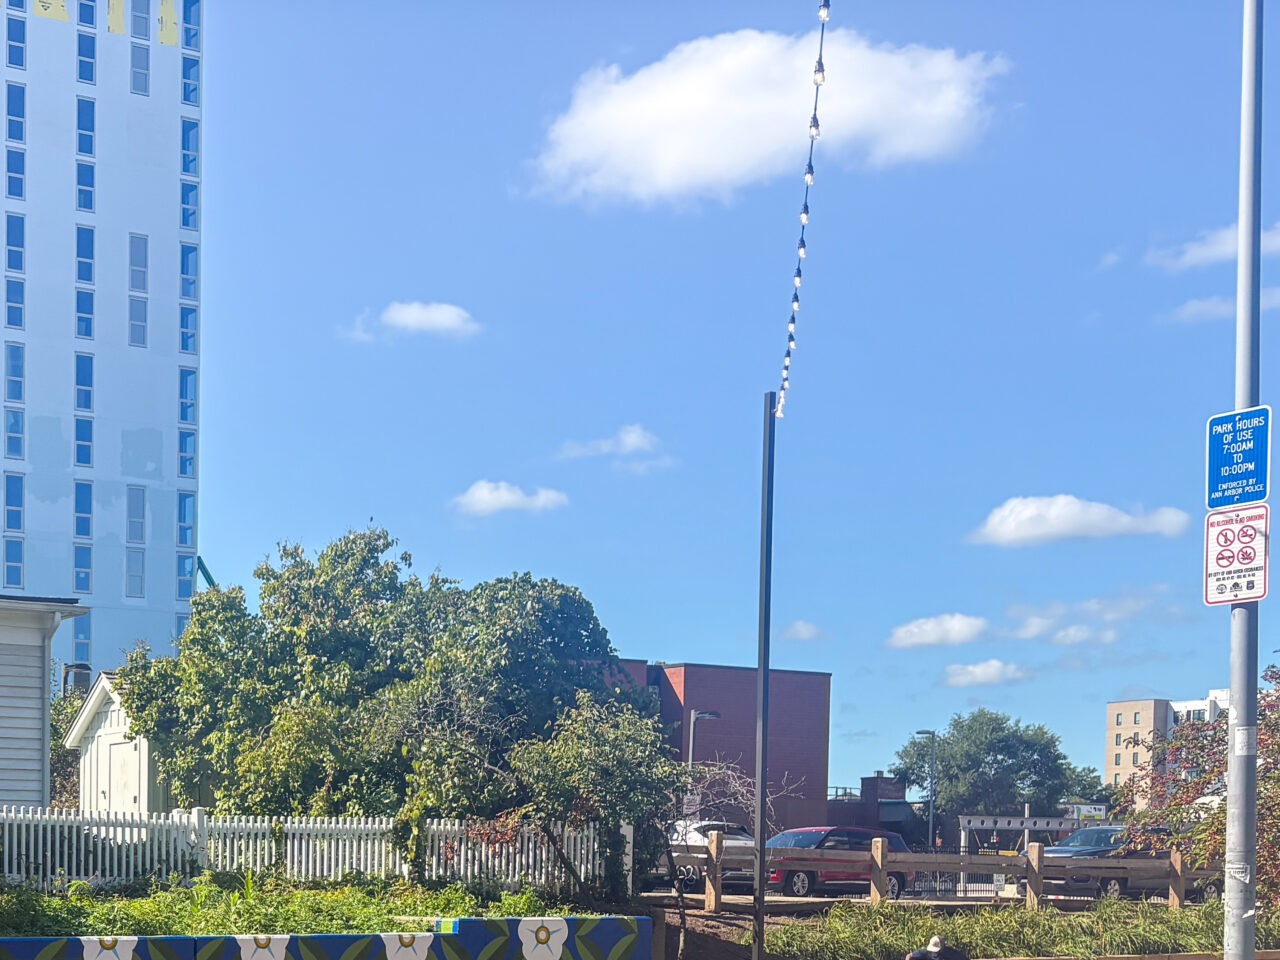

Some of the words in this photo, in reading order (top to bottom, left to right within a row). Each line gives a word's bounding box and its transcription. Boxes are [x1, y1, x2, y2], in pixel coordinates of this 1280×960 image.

[1213, 423, 1233, 435] PARK
[1236, 417, 1264, 429] HOURS
[1223, 433, 1234, 443] OF
[1237, 429, 1254, 441] USE
[1223, 440, 1254, 454] 7:00AM
[1233, 453, 1243, 463] TO
[1221, 462, 1255, 476] 10:00PM
[1211, 490, 1223, 499] ANN
[1224, 487, 1243, 497] ARBOR
[1244, 484, 1264, 493] POLICE
[1219, 480, 1246, 490] ENFORCED
